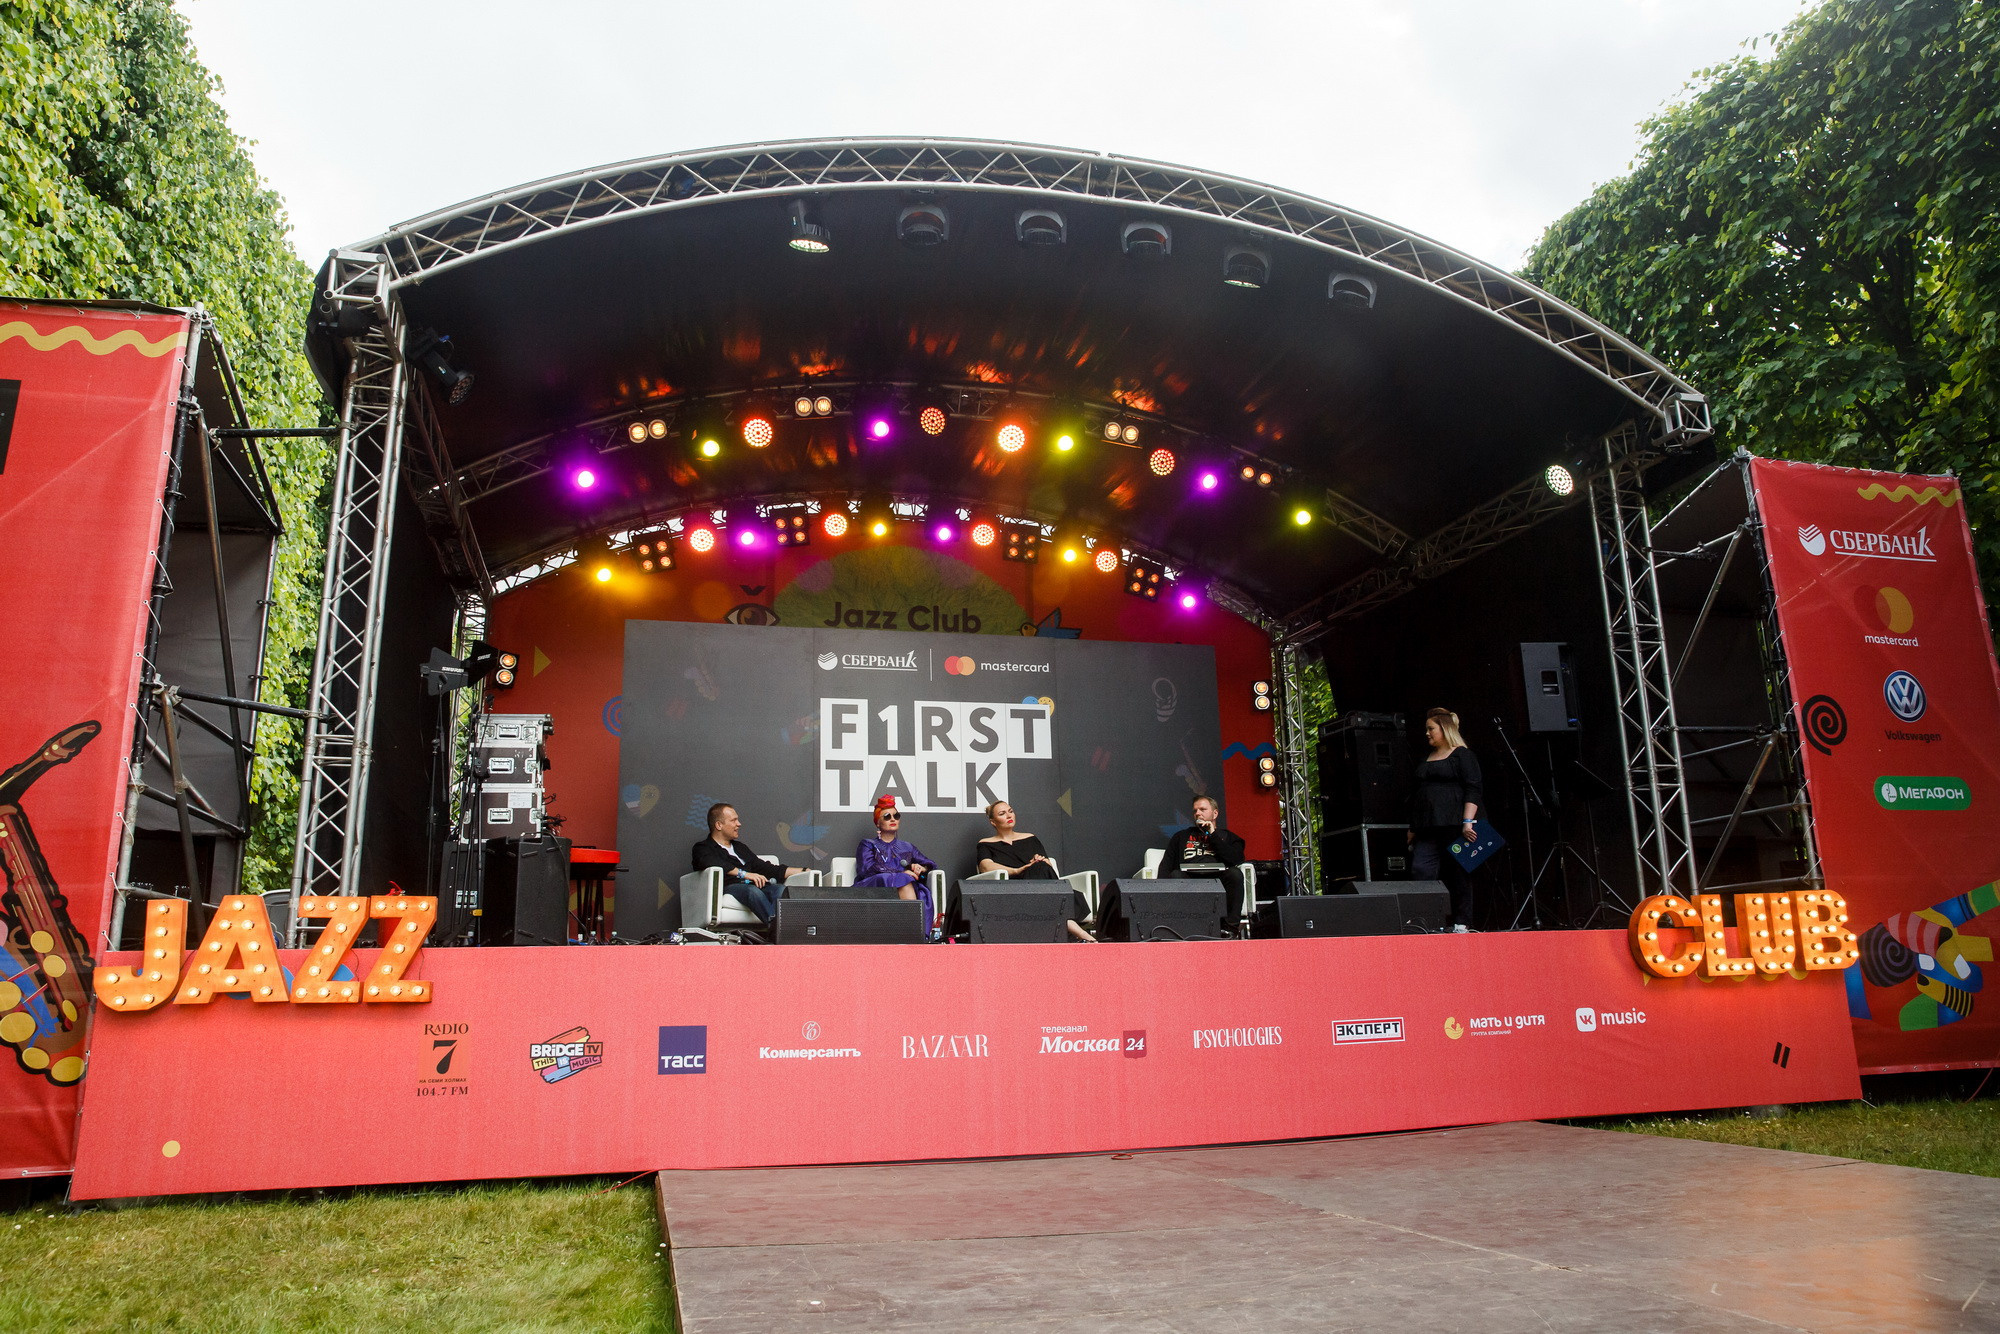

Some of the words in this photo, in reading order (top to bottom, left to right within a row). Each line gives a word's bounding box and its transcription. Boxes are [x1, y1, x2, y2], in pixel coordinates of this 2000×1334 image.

[824, 602, 897, 630] Jazz
[907, 605, 982, 634] Club
[1864, 634, 1919, 647] mastercard
[981, 661, 1050, 673] mastercard
[831, 703, 1046, 754] F1RST
[1884, 730, 1942, 743] Volkswagen
[825, 759, 1002, 808] TALK
[1628, 889, 1859, 978] CLUB
[93, 894, 438, 1012] JAZZ
[1470, 1017, 1502, 1028] мать
[1601, 1007, 1647, 1025] music
[424, 1023, 469, 1036] RADIO
[1041, 1025, 1088, 1034] телеканал
[1337, 1022, 1400, 1036] ЭКСПЕРТ
[1039, 1036, 1120, 1053] Москва
[1126, 1037, 1145, 1051] 24
[1193, 1026, 1282, 1049] PSYCHOLOGIES
[586, 1044, 600, 1054] TV
[759, 1047, 861, 1060] Коммерсантъ
[901, 1034, 989, 1059] BAZAAR
[432, 1039, 458, 1075] 7
[535, 1057, 555, 1067] THIS
[572, 1056, 598, 1068] MUSIC
[417, 1086, 447, 1097] 104.7
[451, 1086, 468, 1096] FM
